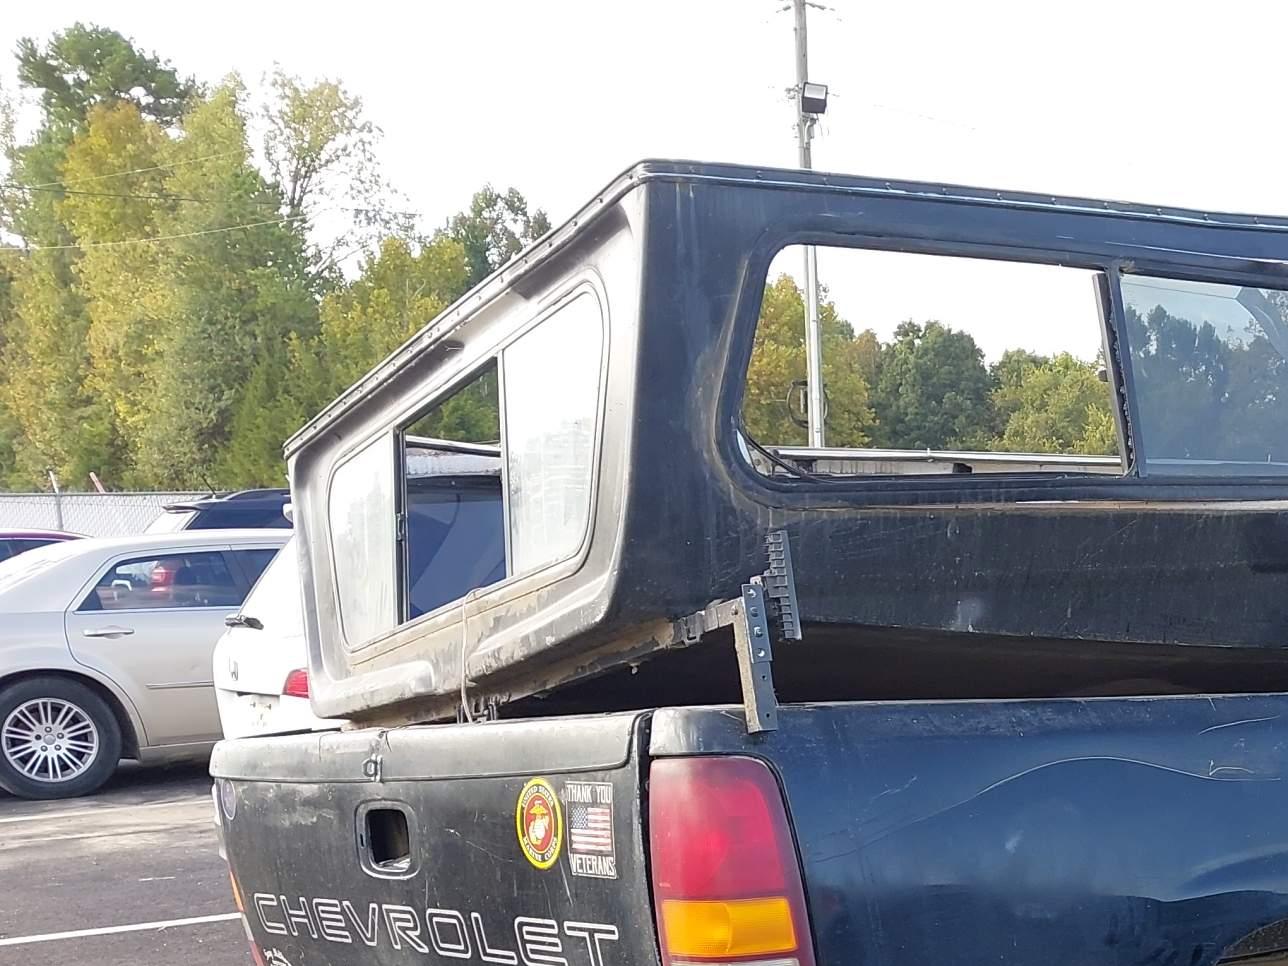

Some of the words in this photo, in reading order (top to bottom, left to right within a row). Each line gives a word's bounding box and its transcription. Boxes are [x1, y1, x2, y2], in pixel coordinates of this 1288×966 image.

[567, 784, 593, 803] THANK
[595, 785, 612, 804] YOU
[523, 836, 542, 862] MARINE
[544, 837, 558, 861] CORPS
[570, 853, 615, 876] VETERANS
